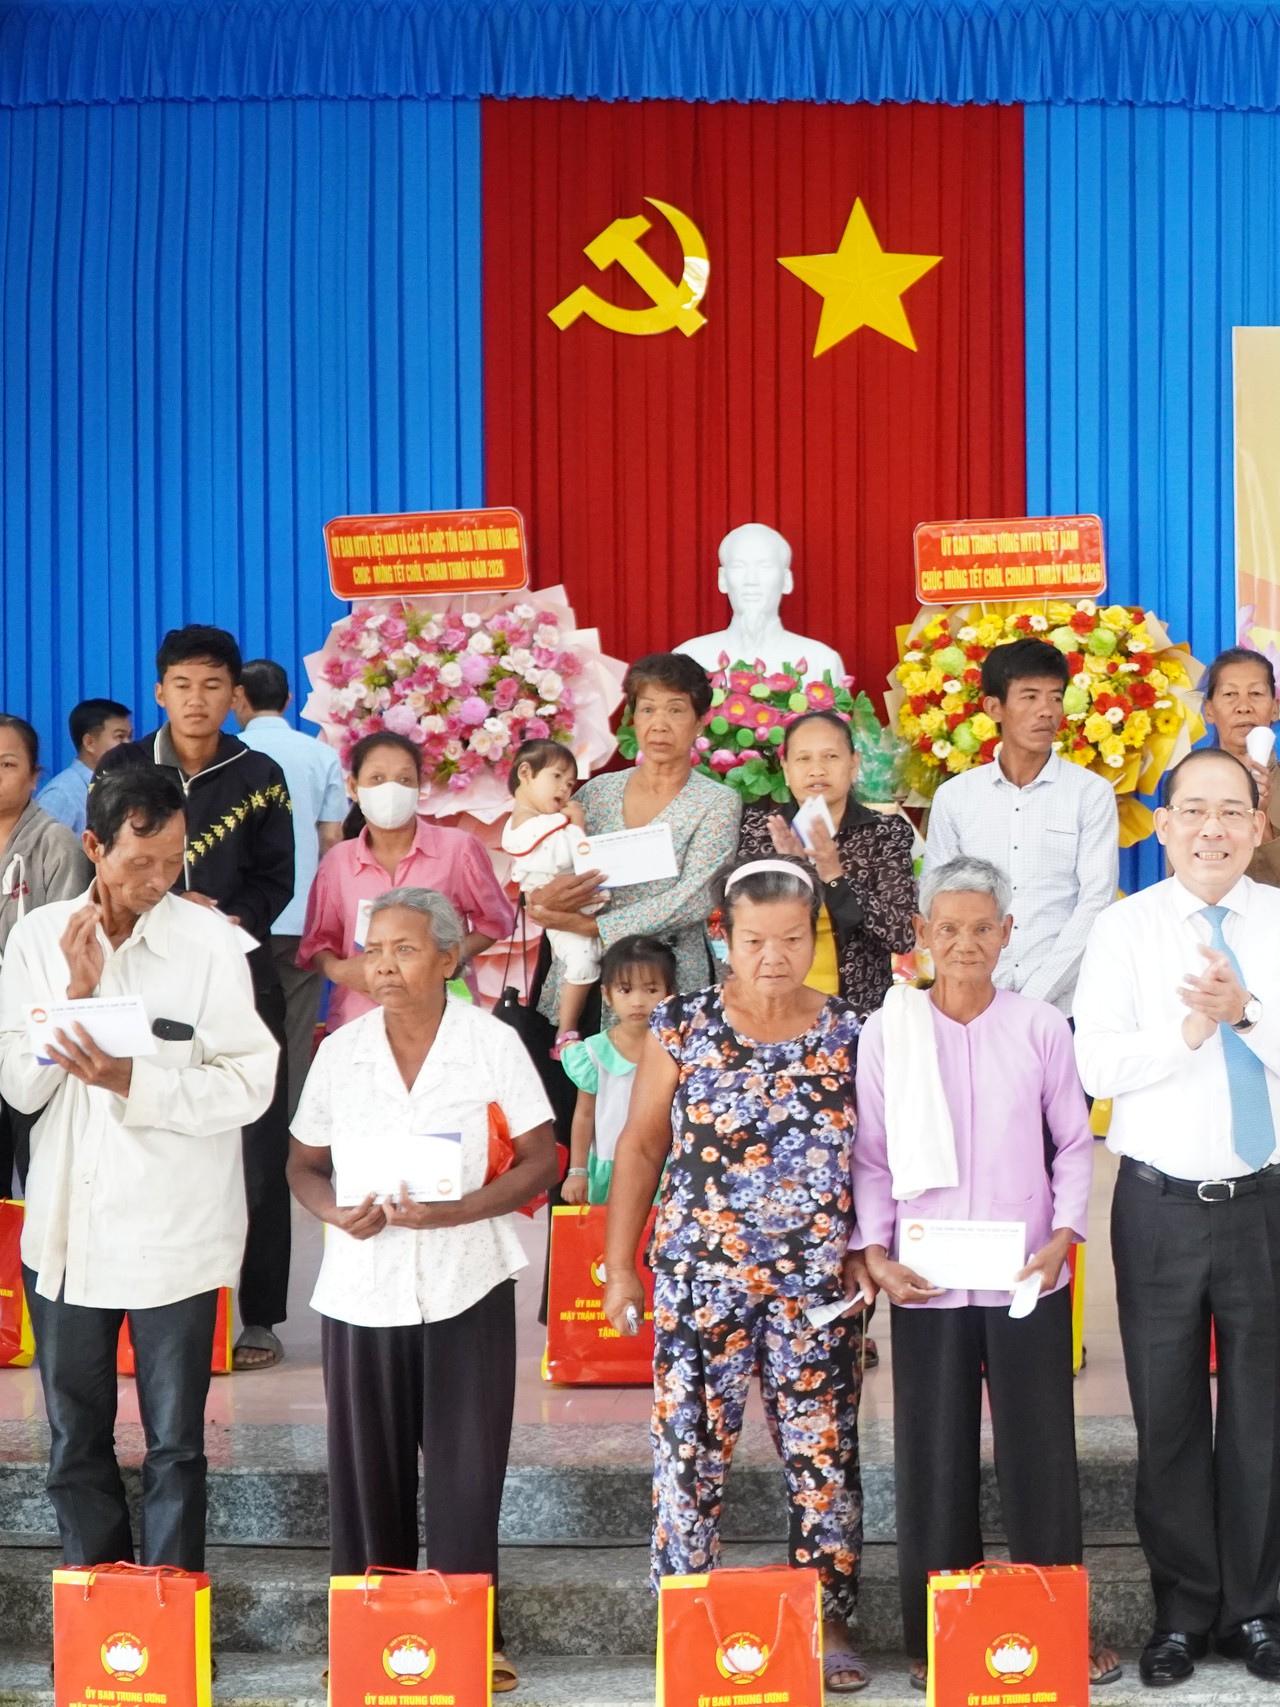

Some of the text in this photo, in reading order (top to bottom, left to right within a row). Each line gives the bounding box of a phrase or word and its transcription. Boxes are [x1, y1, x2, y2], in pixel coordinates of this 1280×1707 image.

[85, 1686, 96, 1700] ỦY
[98, 1690, 115, 1702] BAN
[116, 1691, 143, 1703] TRUNG
[144, 1692, 167, 1704] ƯƠNG
[364, 1693, 455, 1706] ỦY BAN TRUNG ƯƠNG
[698, 1692, 789, 1707] ỦY BAN TRUNG ƯƠNG
[968, 1692, 1057, 1706] ỦY BAN TRUNG ƯƠNG
